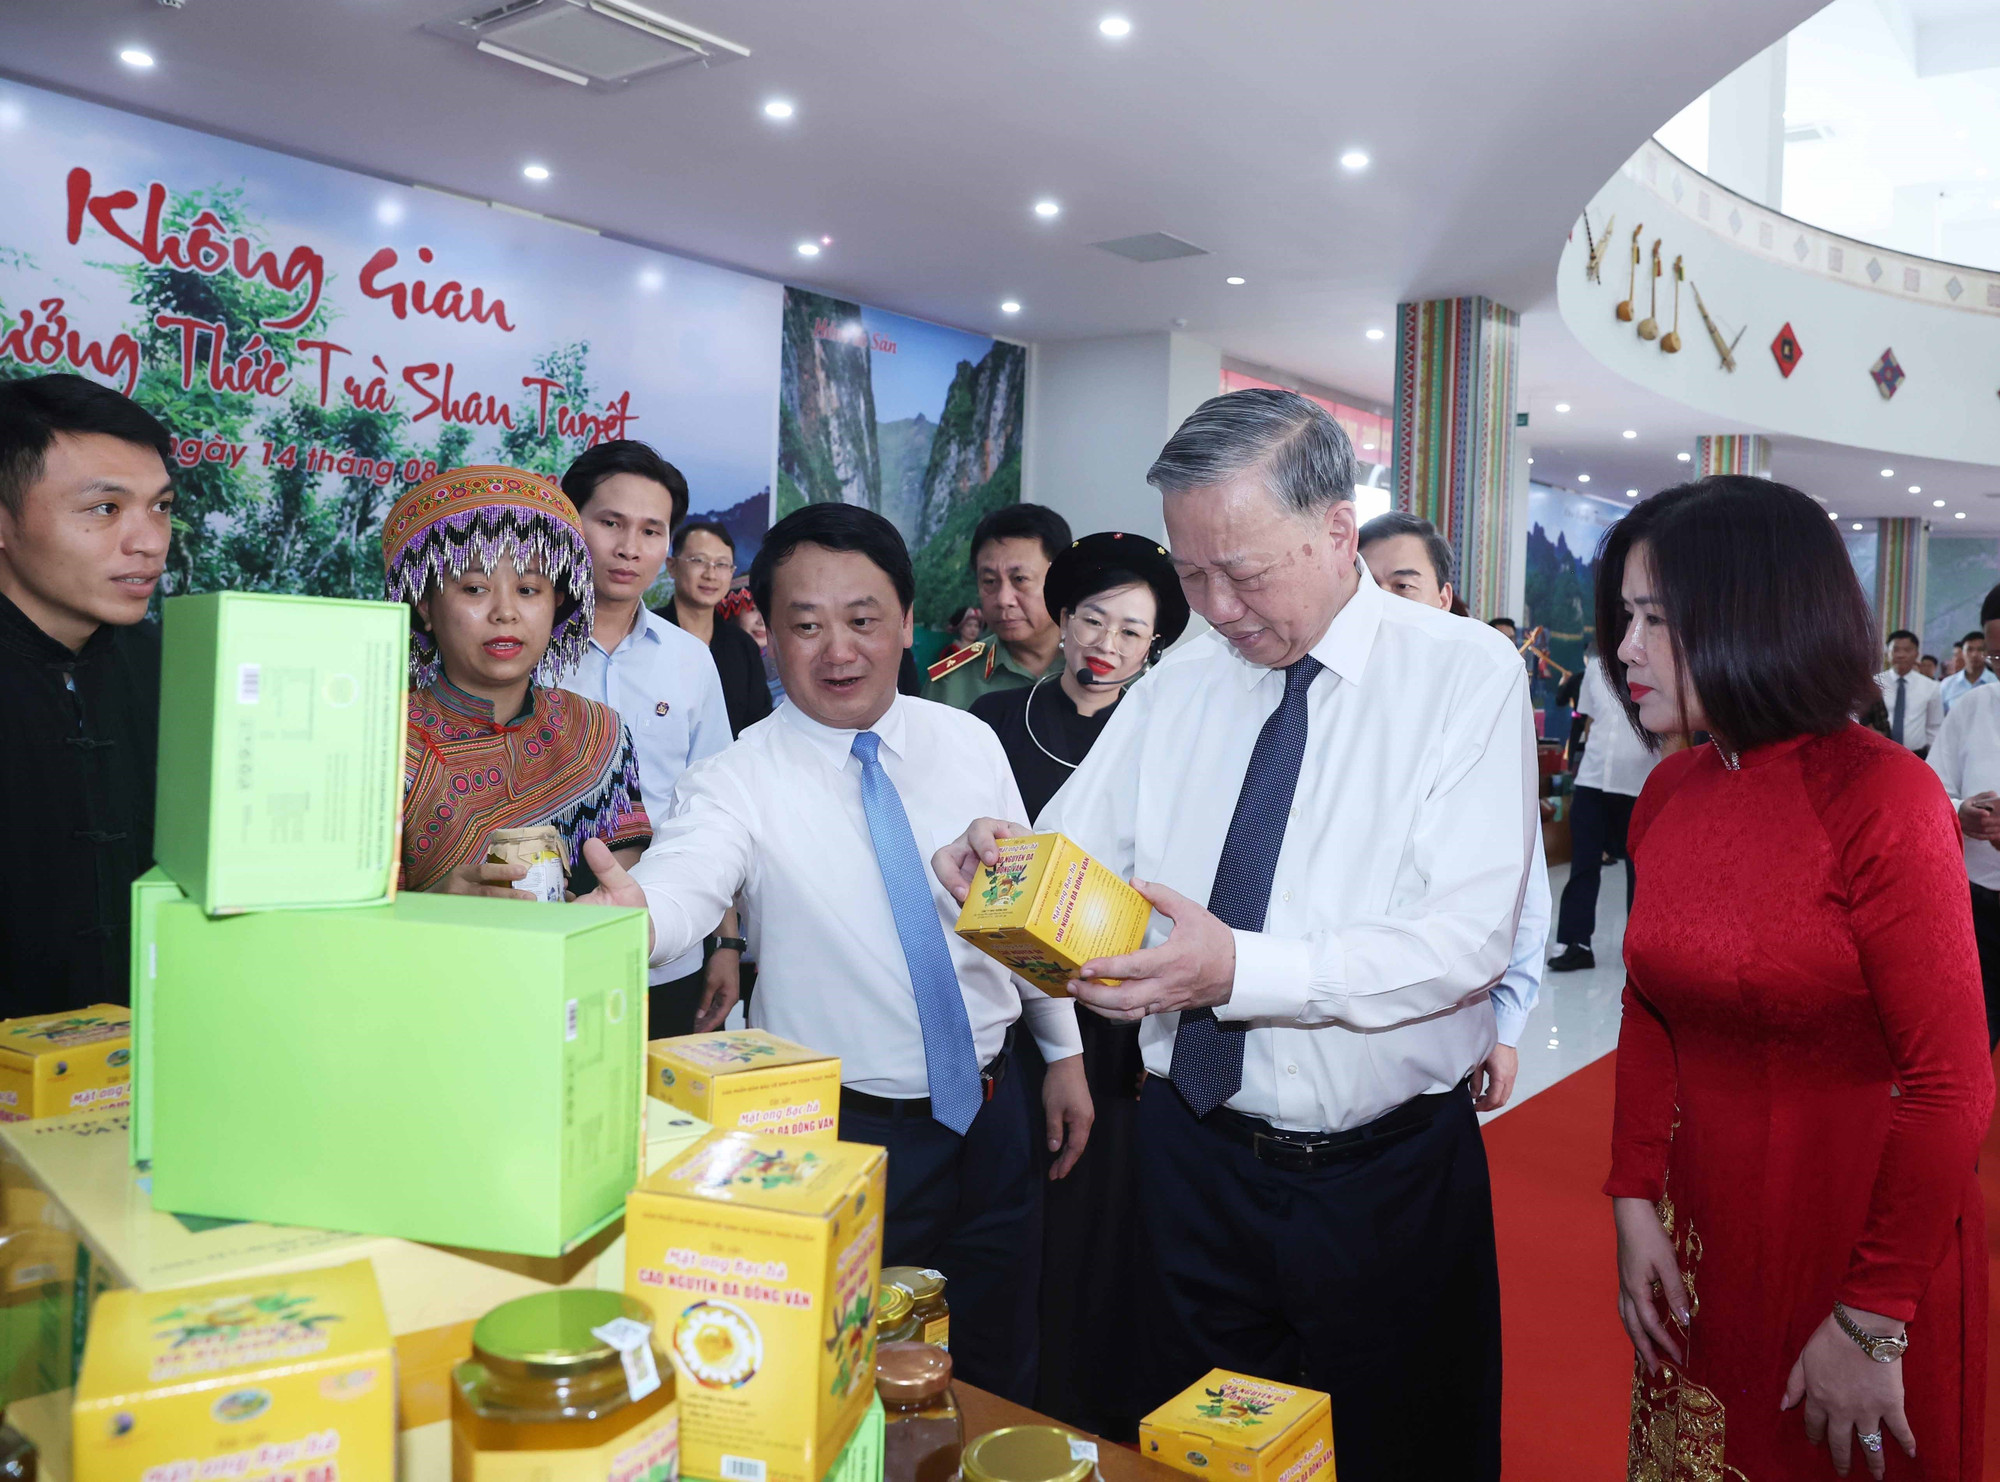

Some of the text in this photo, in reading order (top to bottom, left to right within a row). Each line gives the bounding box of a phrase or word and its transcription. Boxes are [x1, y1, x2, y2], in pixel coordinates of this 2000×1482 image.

[67, 167, 515, 331] Không Gian
[156, 315, 293, 397] Thức
[297, 339, 395, 412] Trà
[402, 363, 516, 431] Shan
[261, 441, 297, 469] 14
[306, 447, 395, 486] tháng
[403, 458, 437, 483] 08
[1055, 927, 1065, 942] CAO
[762, 1109, 783, 1122] ong
[638, 1269, 664, 1285] CAO
